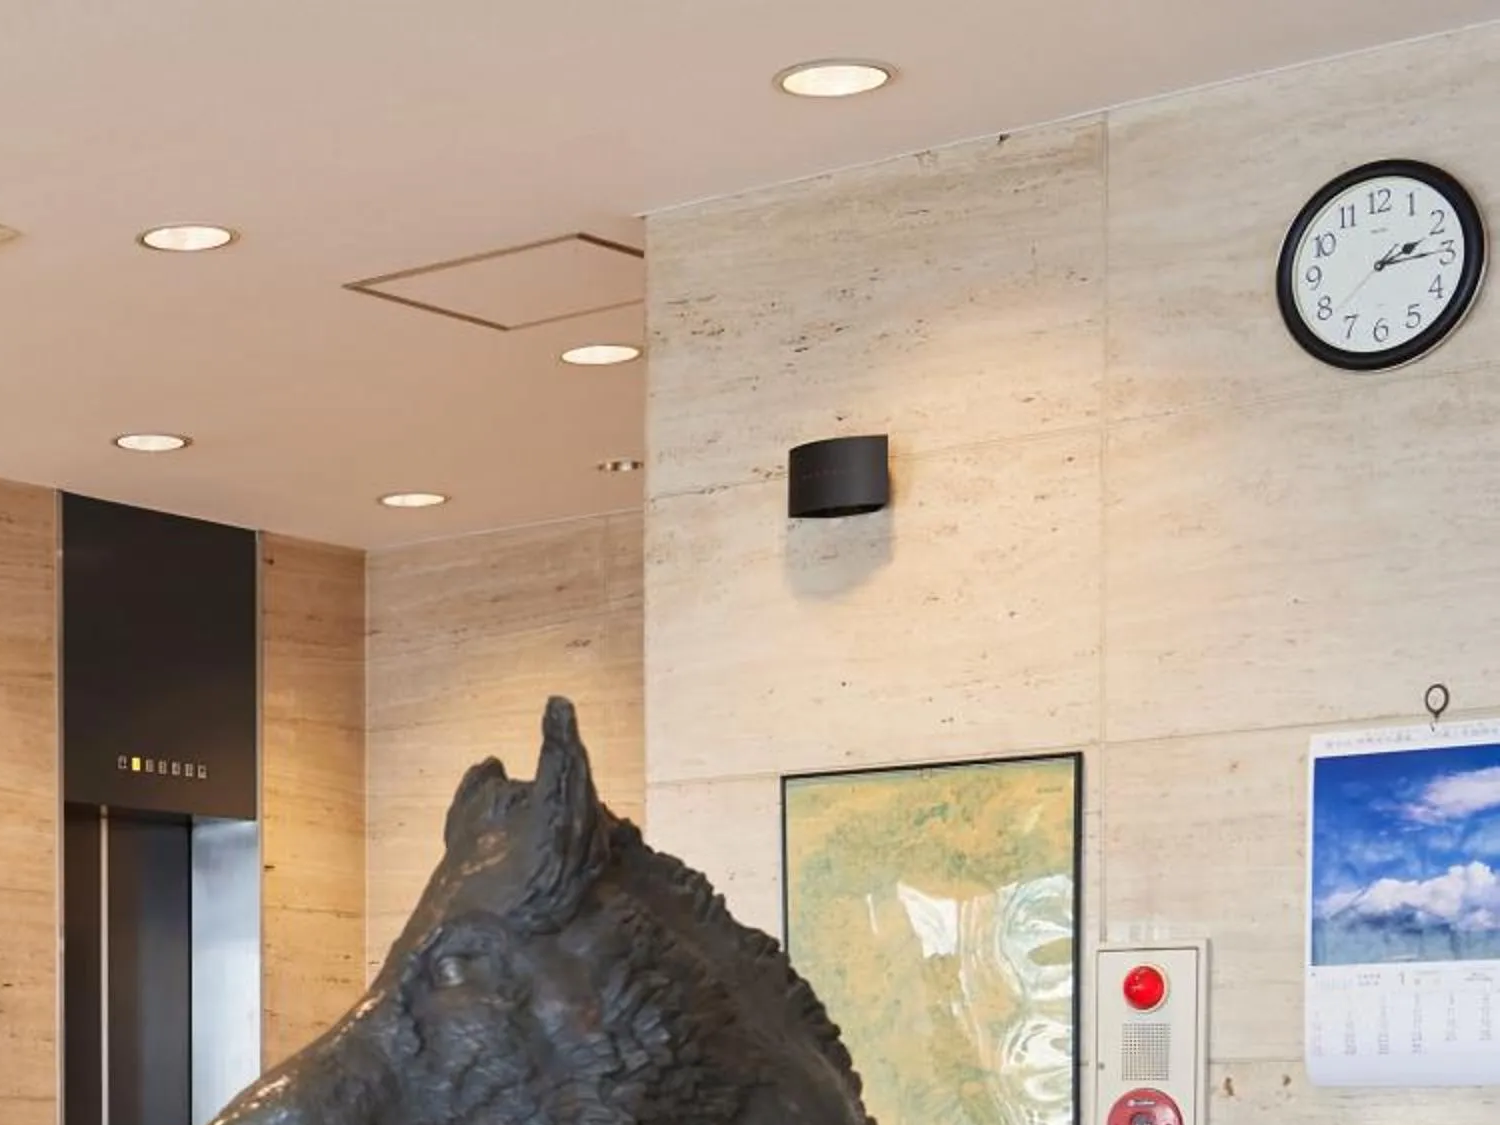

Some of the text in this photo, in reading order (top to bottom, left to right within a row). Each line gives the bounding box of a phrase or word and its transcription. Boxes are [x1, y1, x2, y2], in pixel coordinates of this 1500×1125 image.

[1368, 189, 1391, 214] 12
[1407, 192, 1416, 216] 1
[1339, 204, 1356, 229] 11
[1430, 210, 1445, 235] 2
[1312, 232, 1338, 259] 10
[1439, 239, 1457, 266] 3
[1305, 265, 1322, 291] 9
[1428, 273, 1444, 299] 4
[1316, 295, 1333, 321] 8
[1405, 303, 1422, 329] 5
[1343, 313, 1358, 339] 7
[1373, 317, 1388, 342] 6
